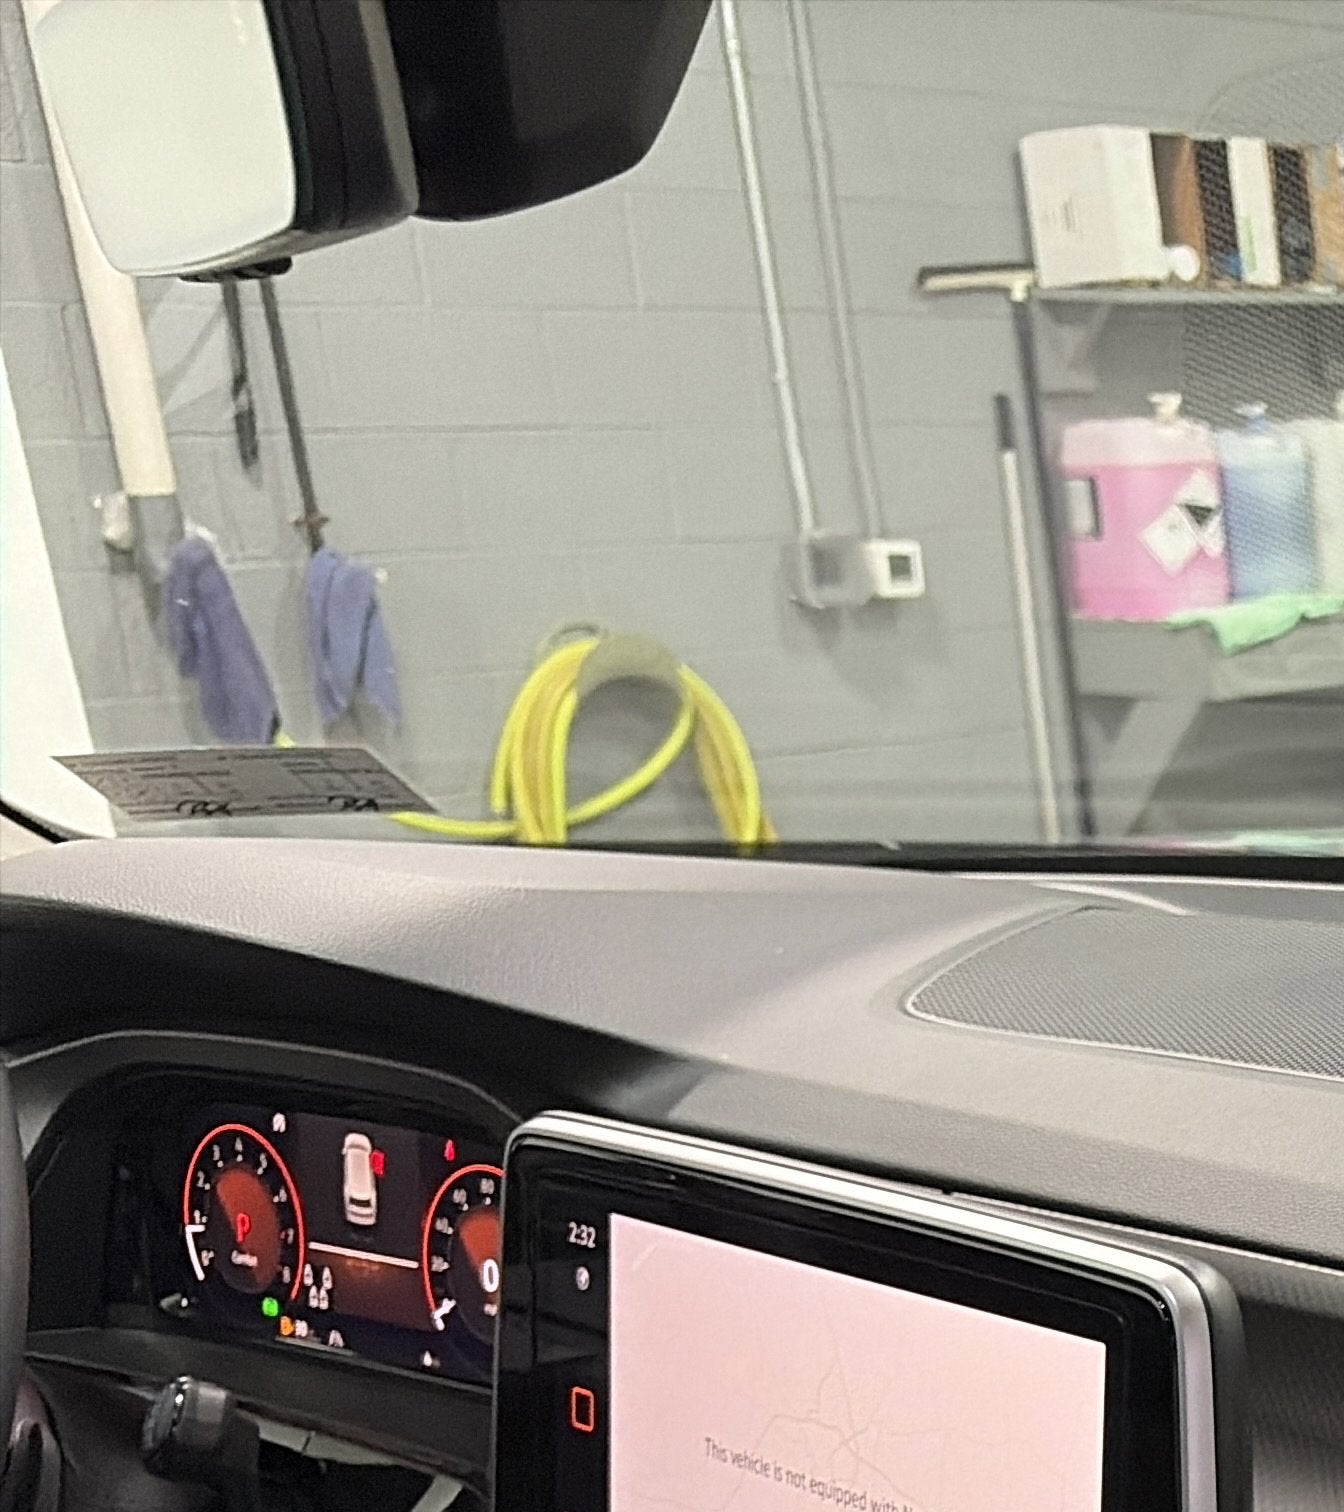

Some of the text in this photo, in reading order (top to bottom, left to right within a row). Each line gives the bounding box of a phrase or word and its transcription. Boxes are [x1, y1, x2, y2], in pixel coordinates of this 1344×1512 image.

[235, 1212, 250, 1243] P
[569, 1220, 597, 1249] 2:32
[704, 1436, 728, 1464] This
[730, 1450, 771, 1478] vehicle
[773, 1460, 784, 1483] is
[785, 1469, 808, 1491] not
[809, 1477, 868, 1512] equipped
